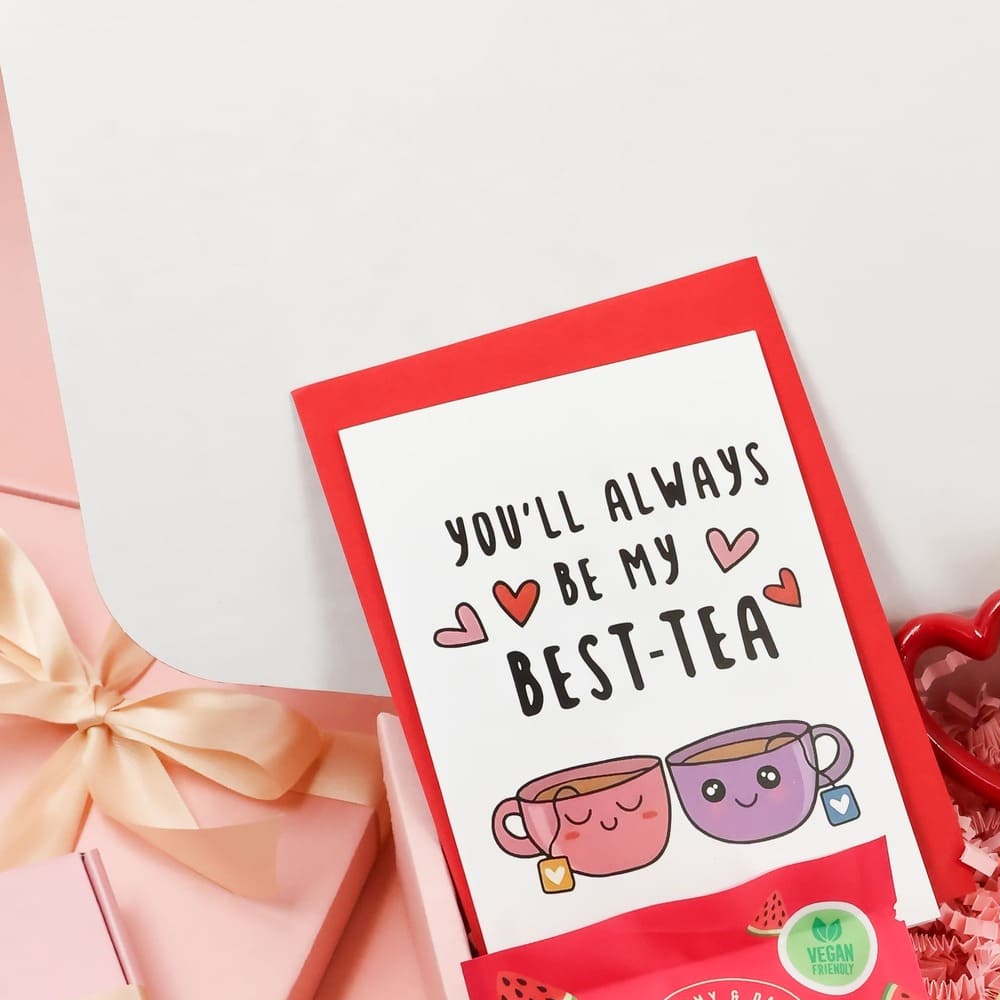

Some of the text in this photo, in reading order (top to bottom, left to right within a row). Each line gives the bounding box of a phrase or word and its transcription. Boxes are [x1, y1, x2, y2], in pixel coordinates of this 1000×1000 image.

[445, 441, 769, 567] YOU'LL ALWAYS
[553, 534, 679, 606] BE MY
[506, 595, 780, 717] BEST-TEA
[807, 943, 855, 963] VEGAN
[811, 962, 855, 977] FRIENDLY
